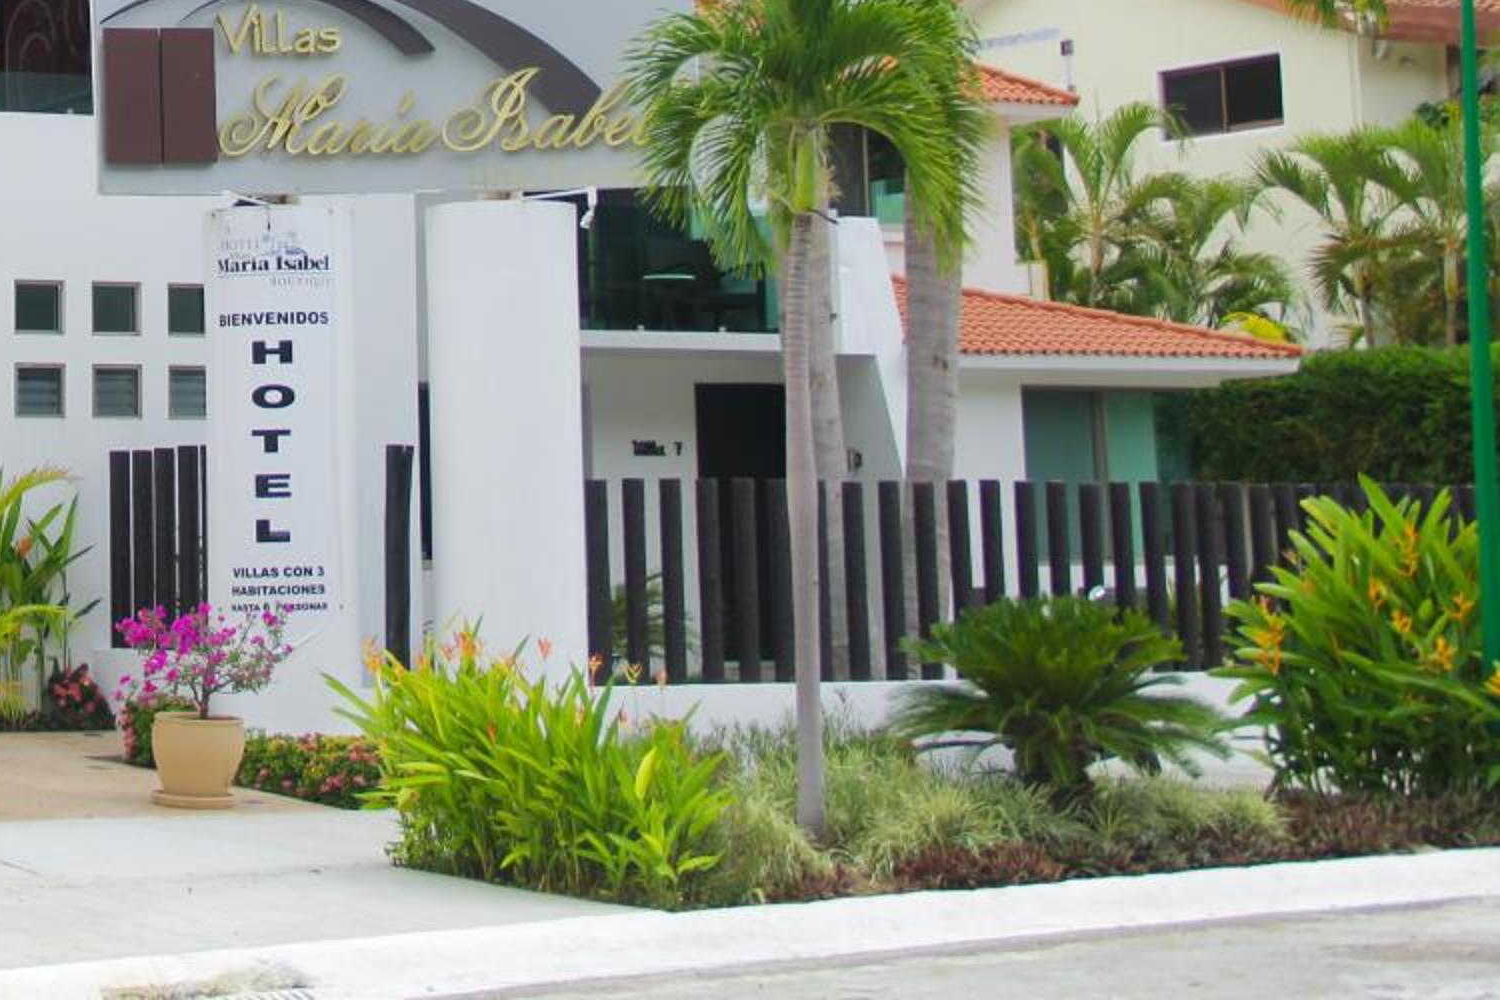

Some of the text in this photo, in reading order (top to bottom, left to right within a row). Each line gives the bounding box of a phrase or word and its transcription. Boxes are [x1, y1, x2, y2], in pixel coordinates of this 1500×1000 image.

[276, 254, 330, 271] Isabel
[219, 311, 330, 327] BIENVENIDOS
[251, 340, 296, 543] HOTEL
[233, 565, 325, 579] VILLAS CON 3
[231, 584, 326, 597] HABITACIONES
